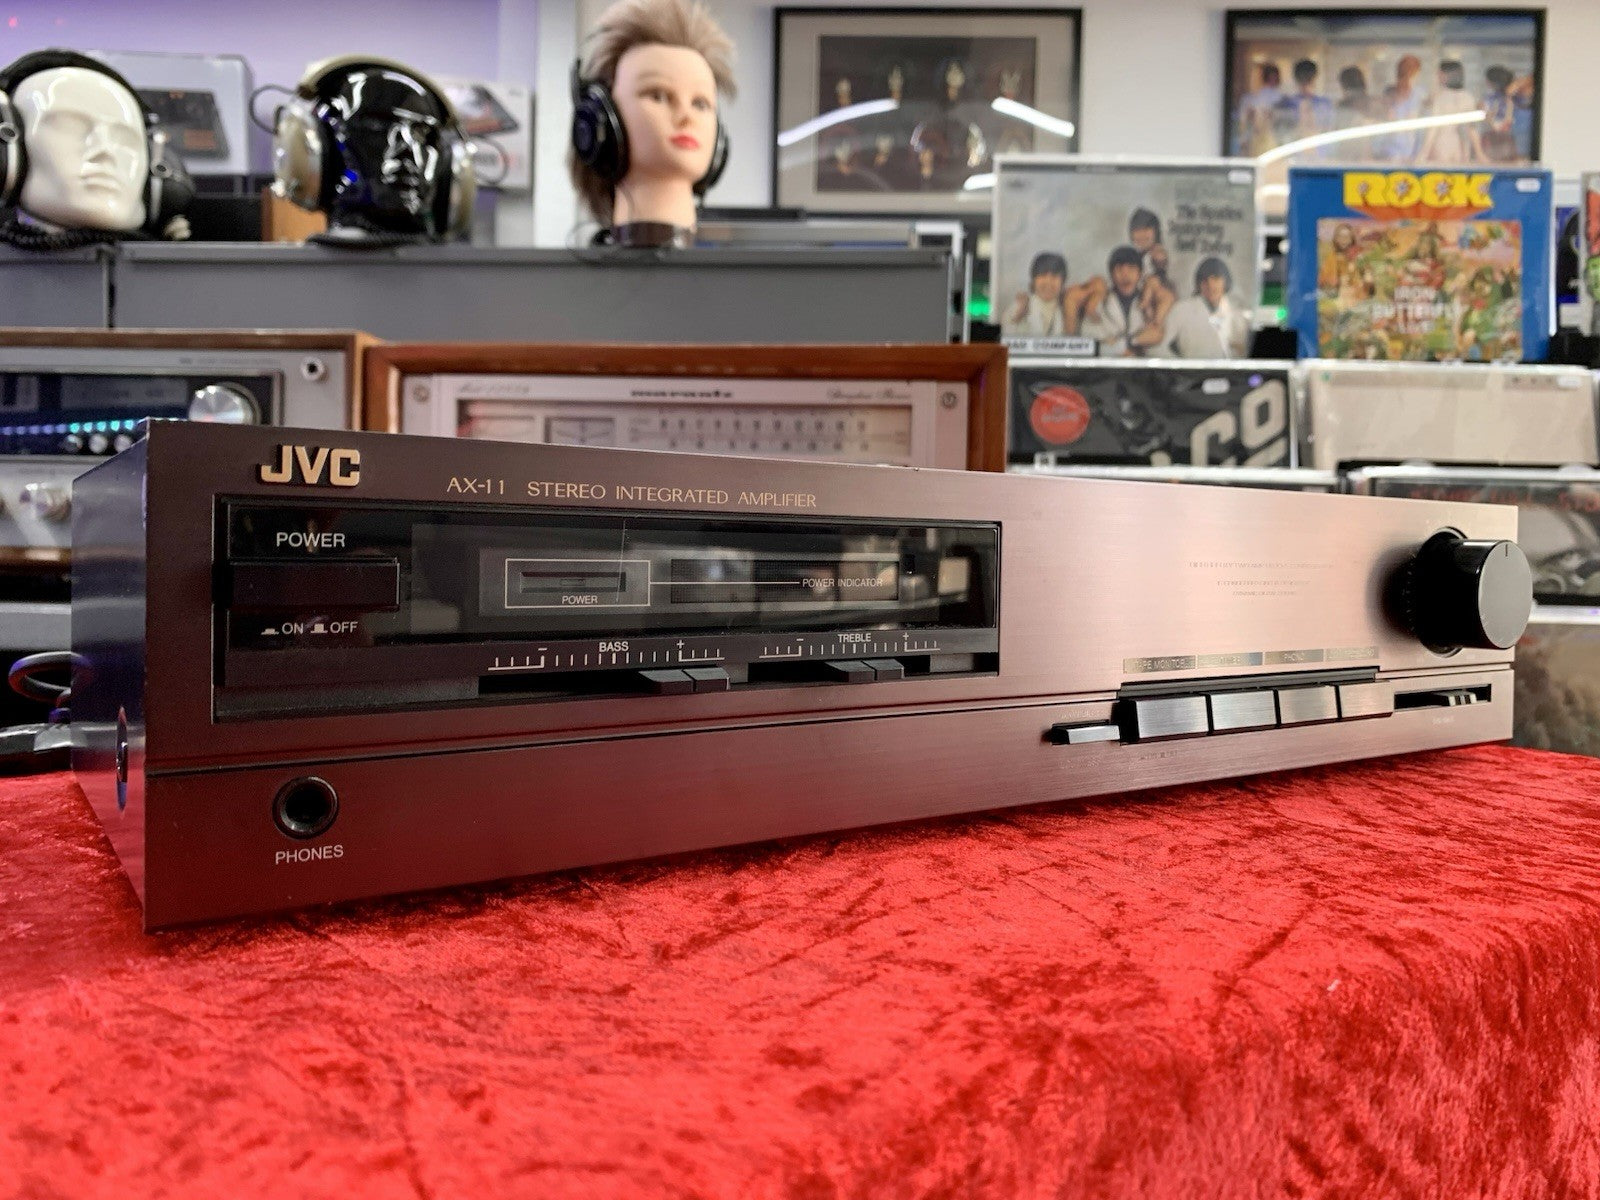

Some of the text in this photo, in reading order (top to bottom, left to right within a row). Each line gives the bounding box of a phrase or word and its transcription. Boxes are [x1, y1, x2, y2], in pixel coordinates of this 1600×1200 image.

[1343, 172, 1494, 208] ROCK
[260, 445, 361, 487] JVC
[446, 477, 818, 508] AX-11 STEREO INTEGRATED AMPLIFIER
[275, 530, 347, 550] POWER
[802, 577, 884, 589] POWER INDICATOR
[561, 594, 599, 606] POWER
[281, 620, 359, 636] ON OFF
[837, 632, 872, 644] TREBLE
[598, 641, 630, 654] BASS
[275, 844, 344, 865] PHONES
